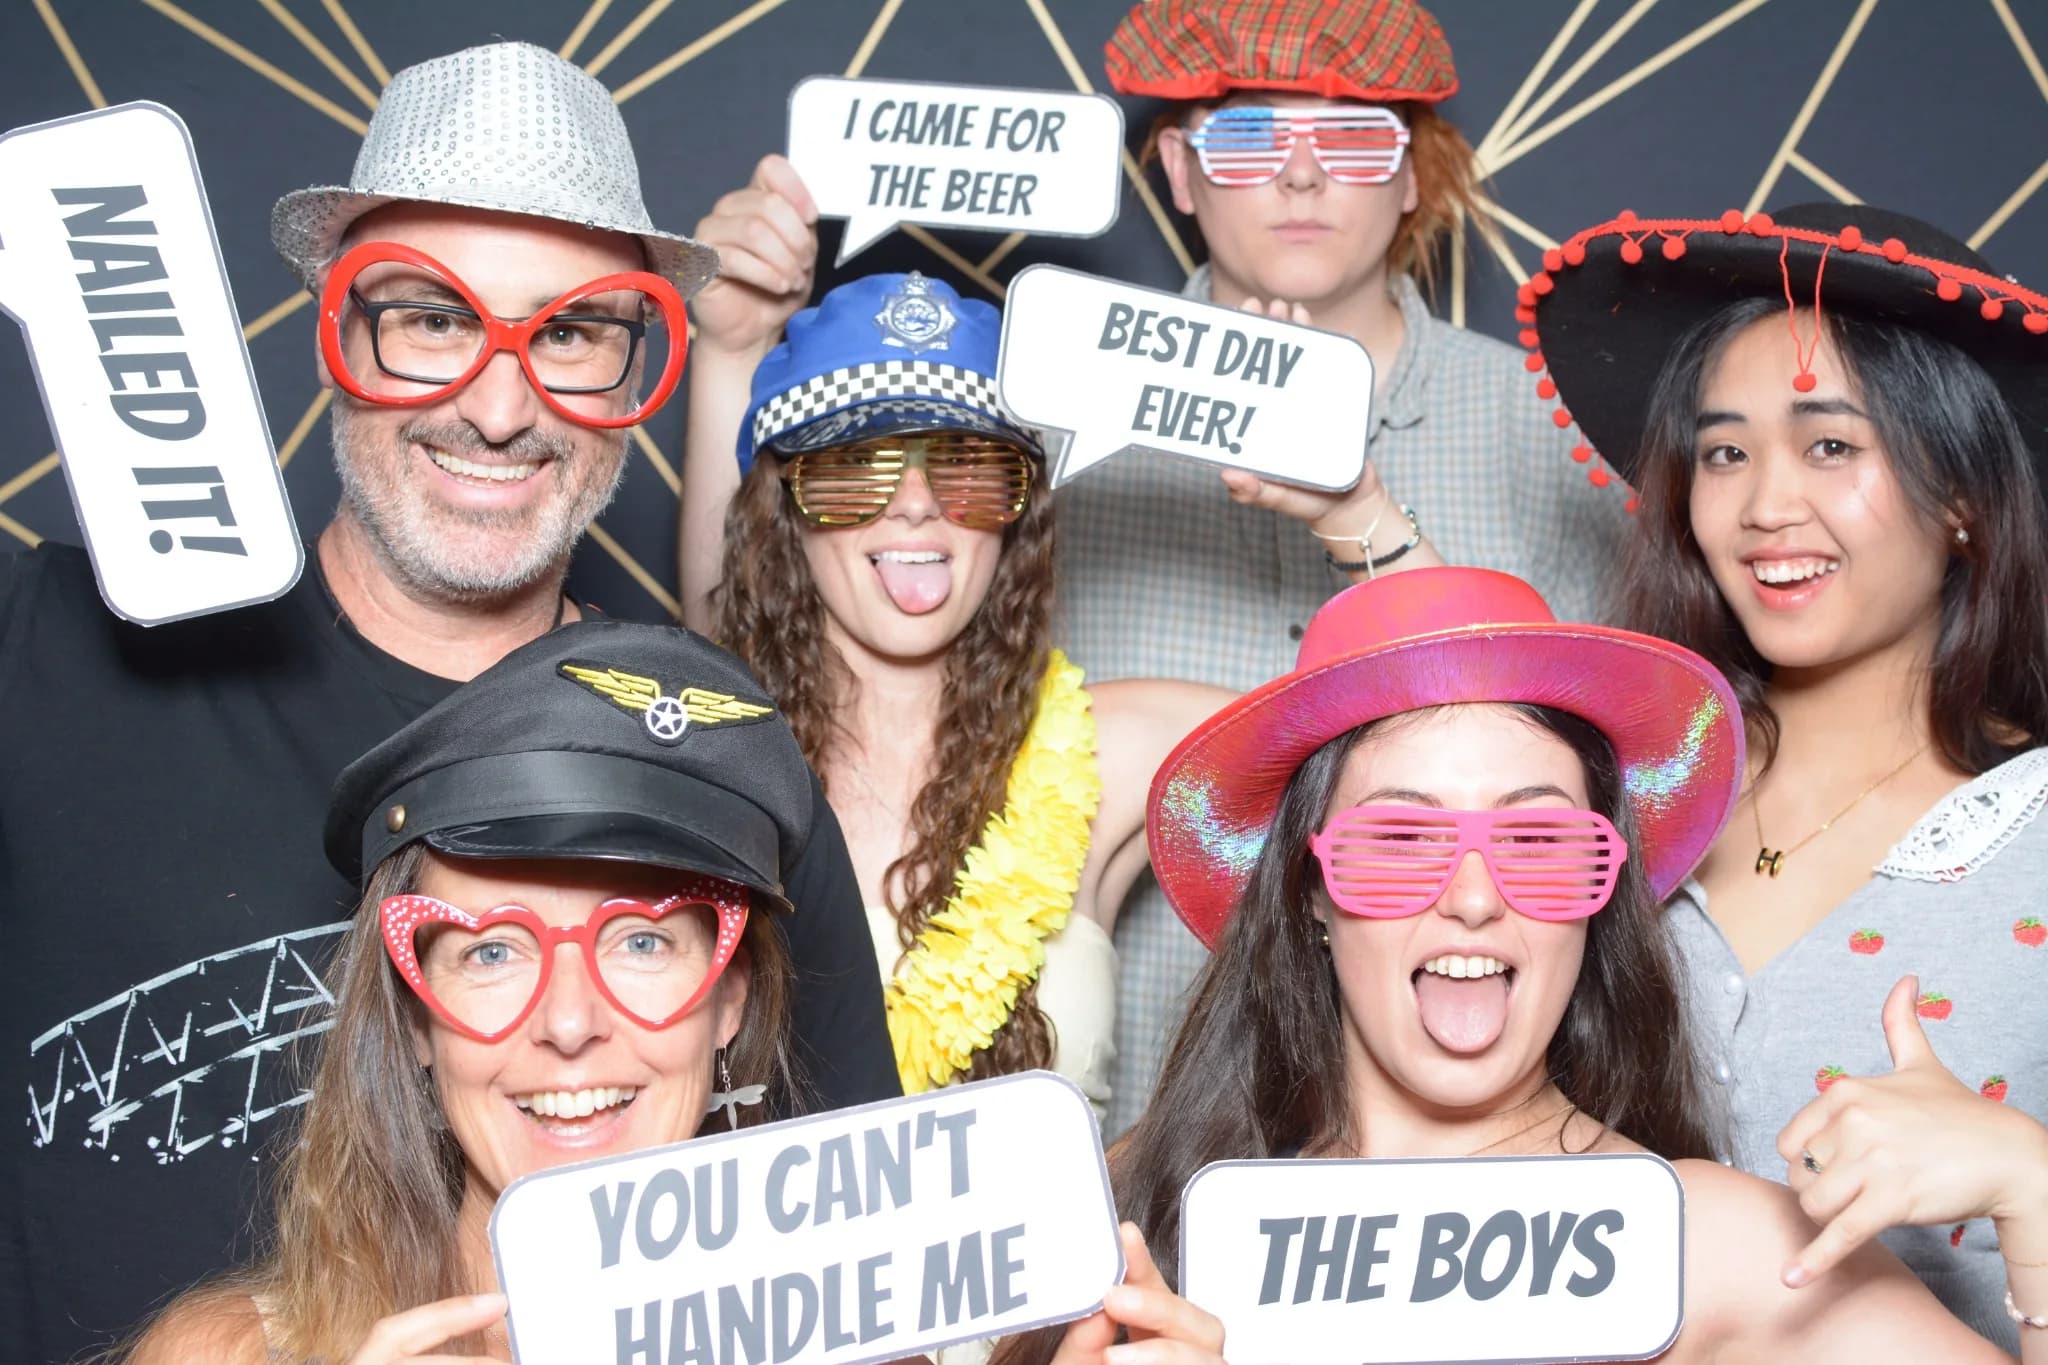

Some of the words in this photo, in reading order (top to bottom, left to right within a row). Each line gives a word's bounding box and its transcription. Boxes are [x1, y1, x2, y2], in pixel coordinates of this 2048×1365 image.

[844, 98, 860, 140] I
[869, 99, 979, 147] CAME
[985, 107, 1066, 152] FOR
[868, 164, 936, 208] THE
[941, 168, 1037, 216] BEER
[50, 184, 207, 441] NAILED
[131, 465, 249, 557] IT!
[1097, 302, 1211, 368] BEST
[1213, 329, 1304, 388] DAY
[1131, 384, 1257, 455] EVER!
[589, 1157, 739, 1270] YOU
[765, 1109, 977, 1234] CAN'T
[614, 1251, 895, 1365] HANDLE
[918, 1223, 1028, 1332] ME
[1258, 1213, 1399, 1306] THE
[1409, 1209, 1625, 1303] BOYS
